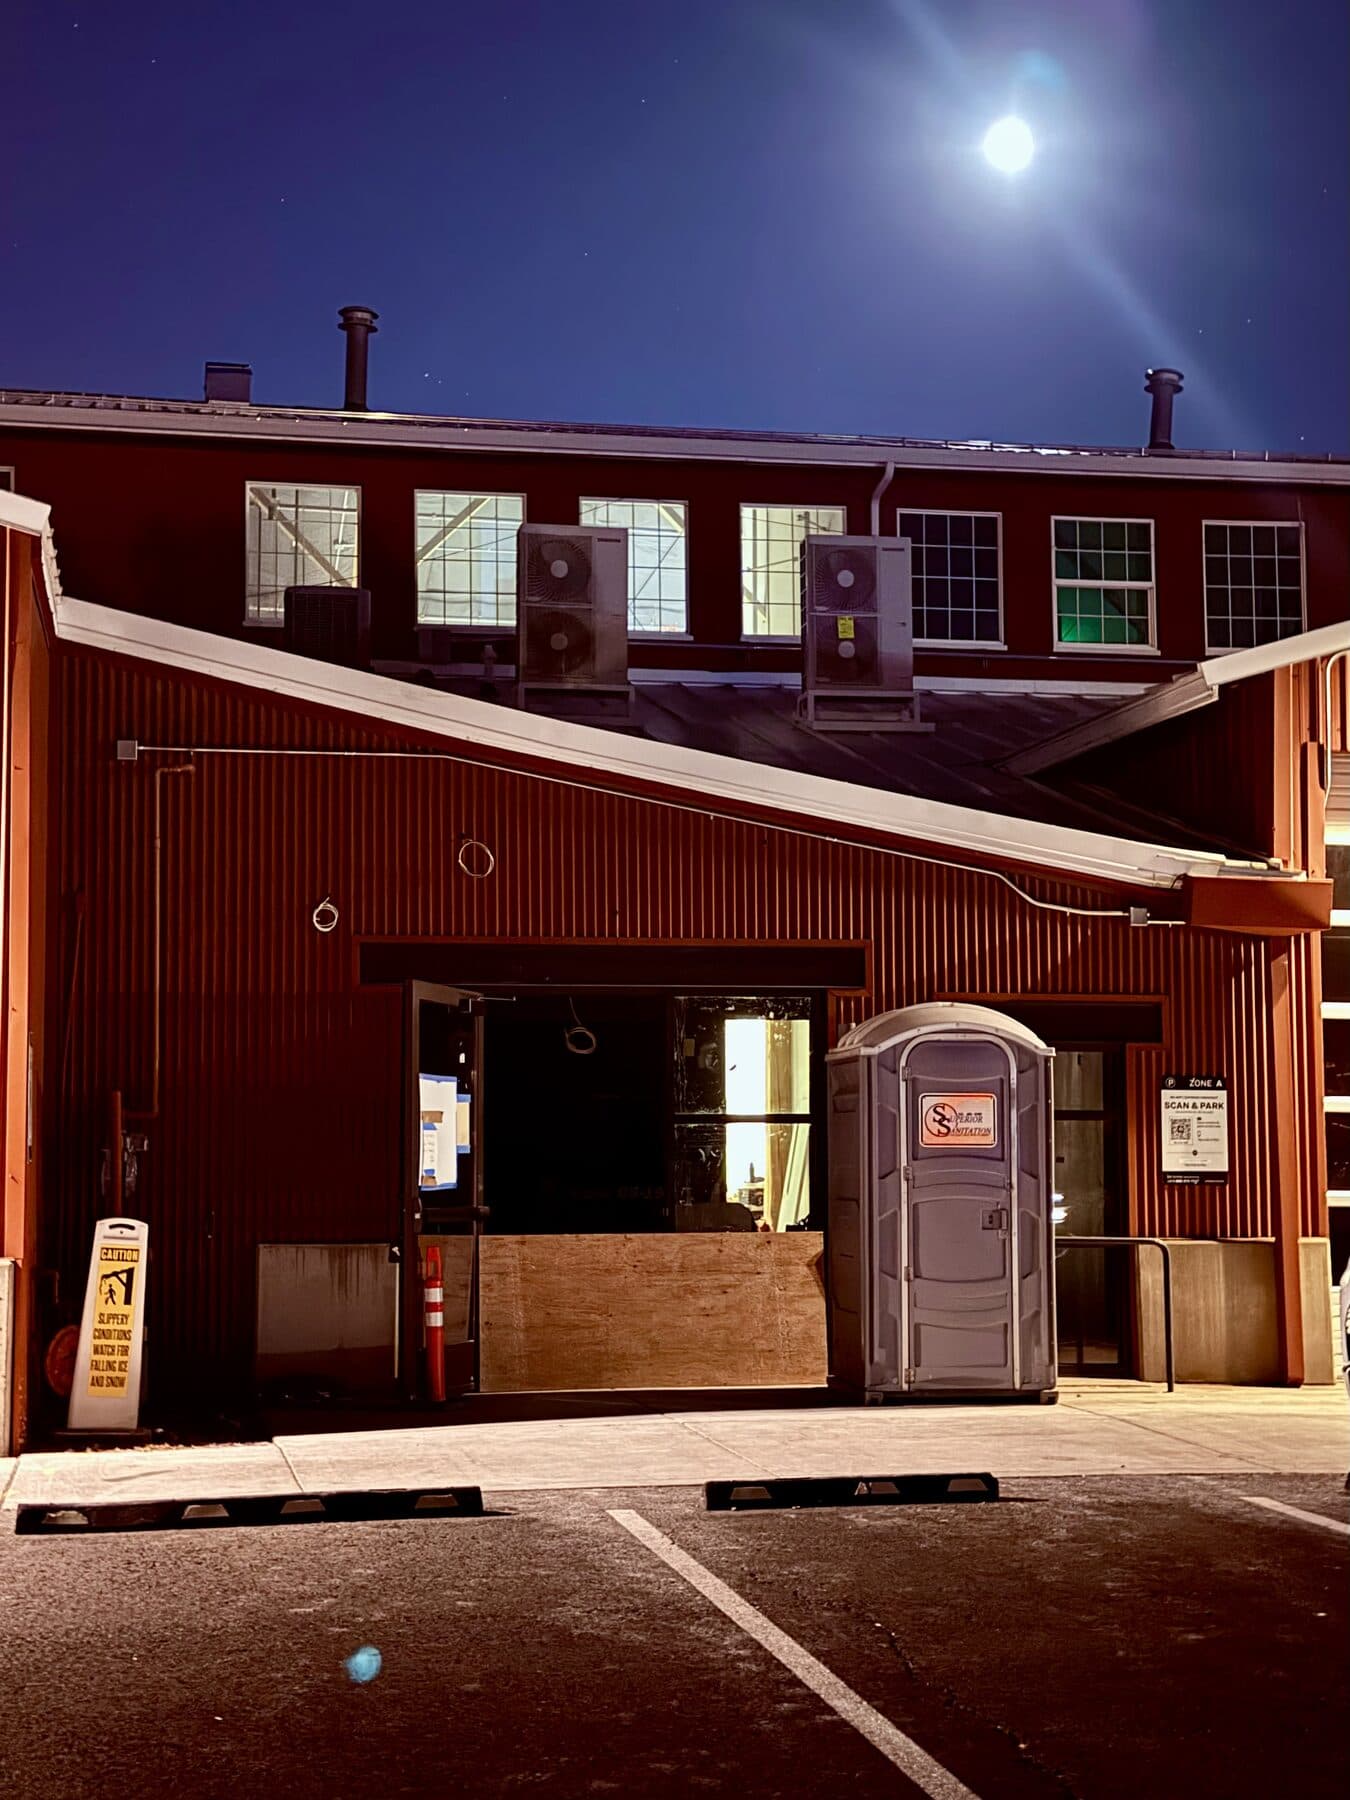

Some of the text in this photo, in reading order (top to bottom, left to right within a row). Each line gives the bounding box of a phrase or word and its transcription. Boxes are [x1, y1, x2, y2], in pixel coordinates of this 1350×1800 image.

[1189, 1078, 1212, 1088] ZONE
[1216, 1079, 1223, 1087] A
[1164, 1101, 1189, 1110] SCAN
[1200, 1102, 1224, 1110] PARK
[101, 1248, 139, 1261] CAUTION
[98, 1312, 129, 1325] SLIPPERY
[93, 1329, 132, 1342] CONDITIONS
[93, 1344, 129, 1357] WATCH FOR
[90, 1360, 128, 1372] FALLING ICE
[90, 1376, 126, 1388] AND SNOW
